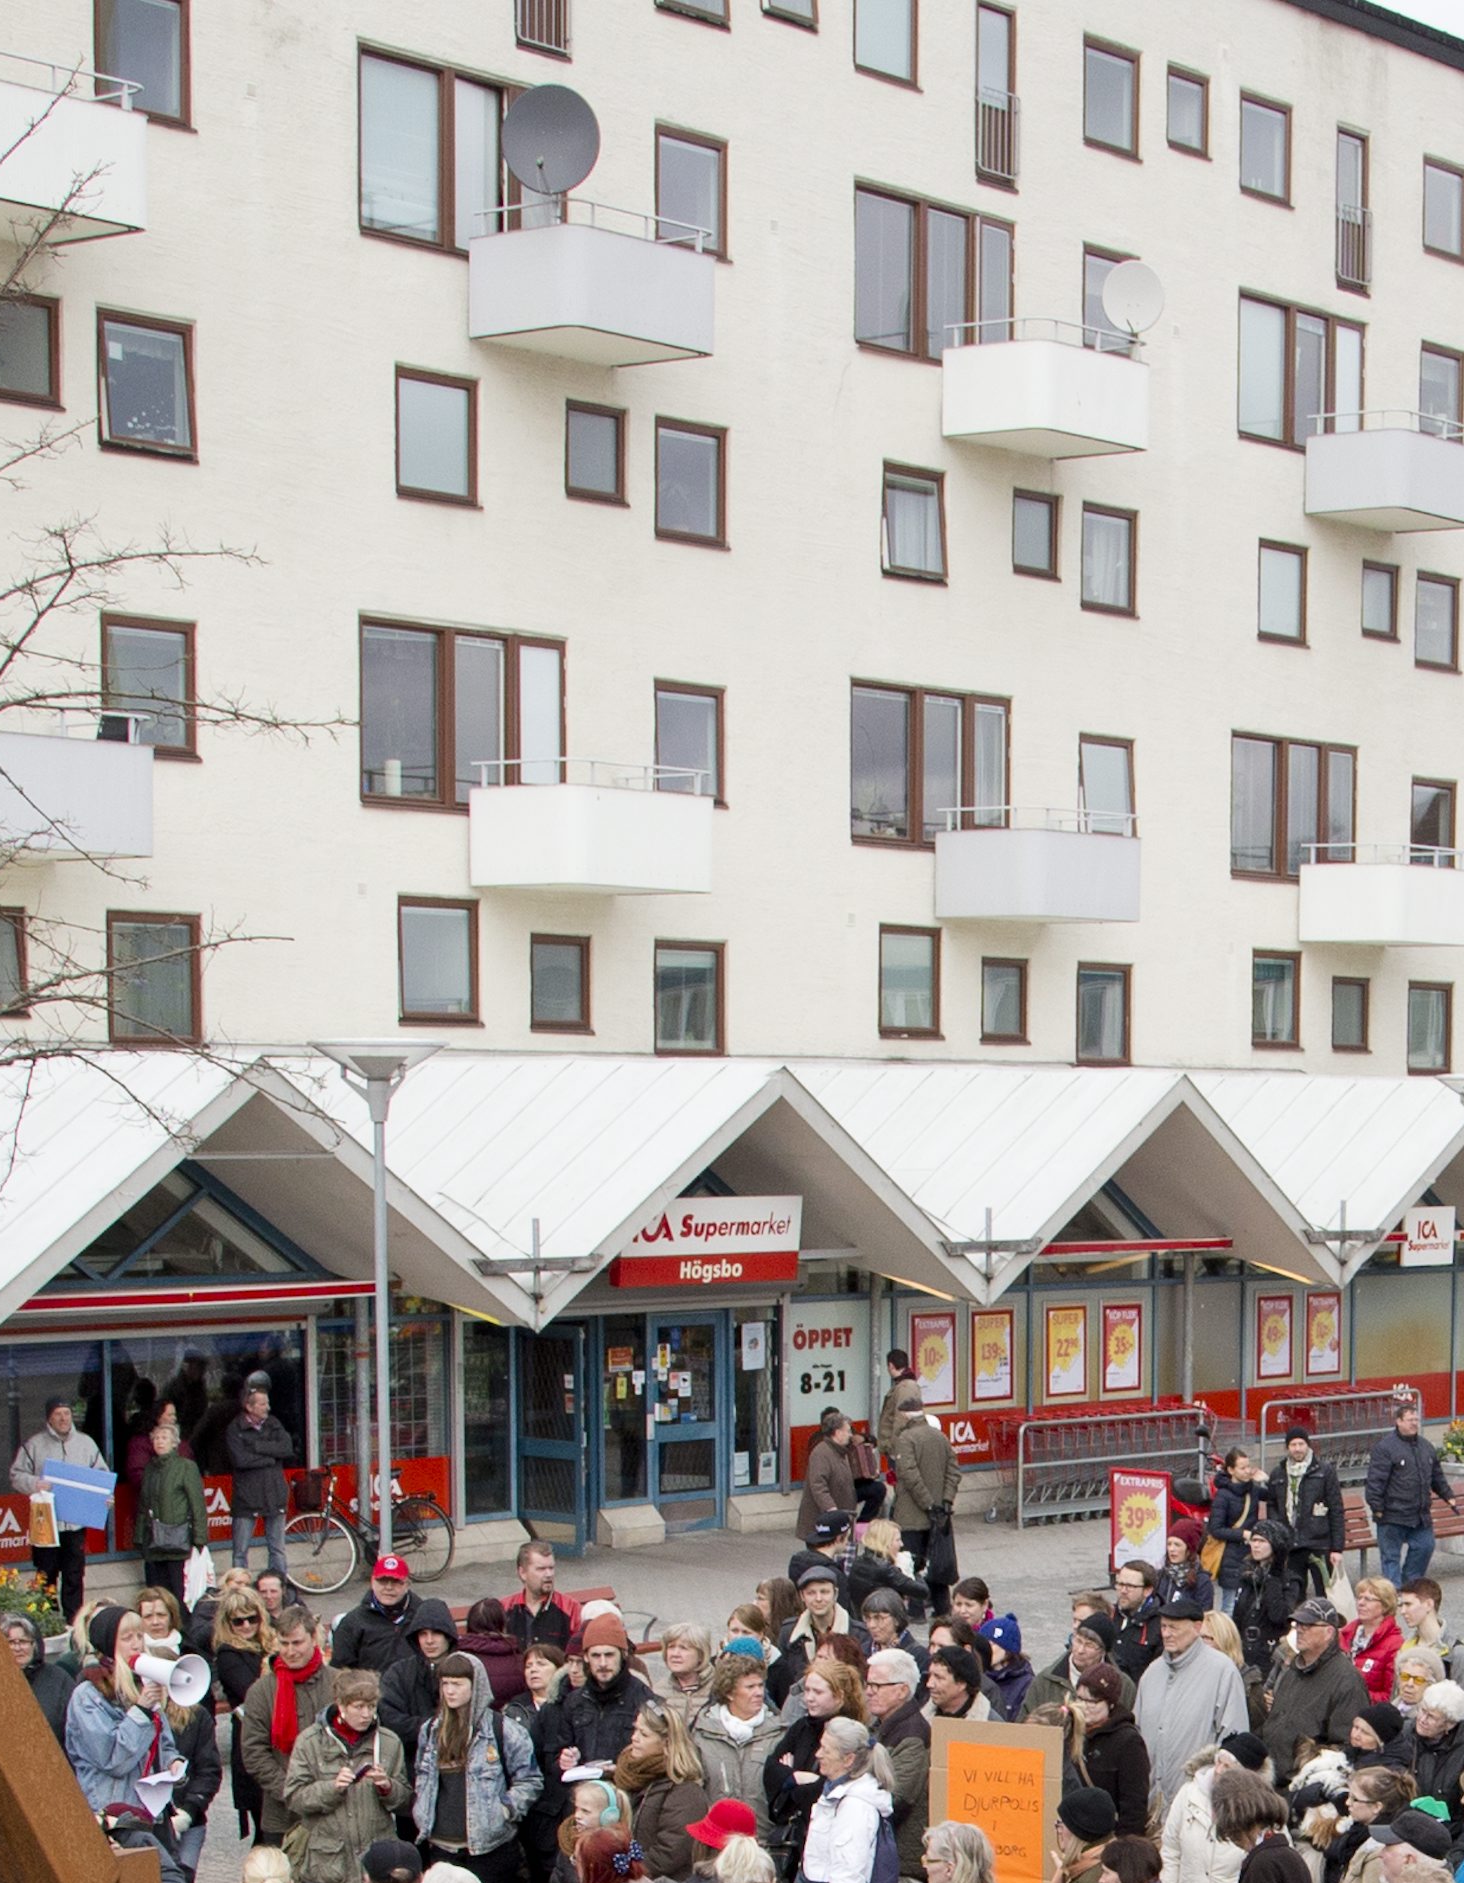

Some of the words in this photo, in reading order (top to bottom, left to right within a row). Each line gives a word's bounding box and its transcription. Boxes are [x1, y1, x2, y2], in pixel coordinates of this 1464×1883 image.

[680, 1211, 792, 1243] Supermarket
[1417, 1220, 1438, 1240] ICA
[679, 1259, 744, 1284] Högsbo
[793, 1323, 853, 1351] ÖPPET
[800, 1370, 846, 1395] 8-21
[949, 1421, 977, 1444] ICA
[1120, 1475, 1165, 1489] EXTRAPRIS
[963, 1769, 977, 1784] VI
[984, 1771, 1010, 1784] VILL
[1017, 1772, 1035, 1788] HA
[963, 1793, 1040, 1818] DJURPOLIS
